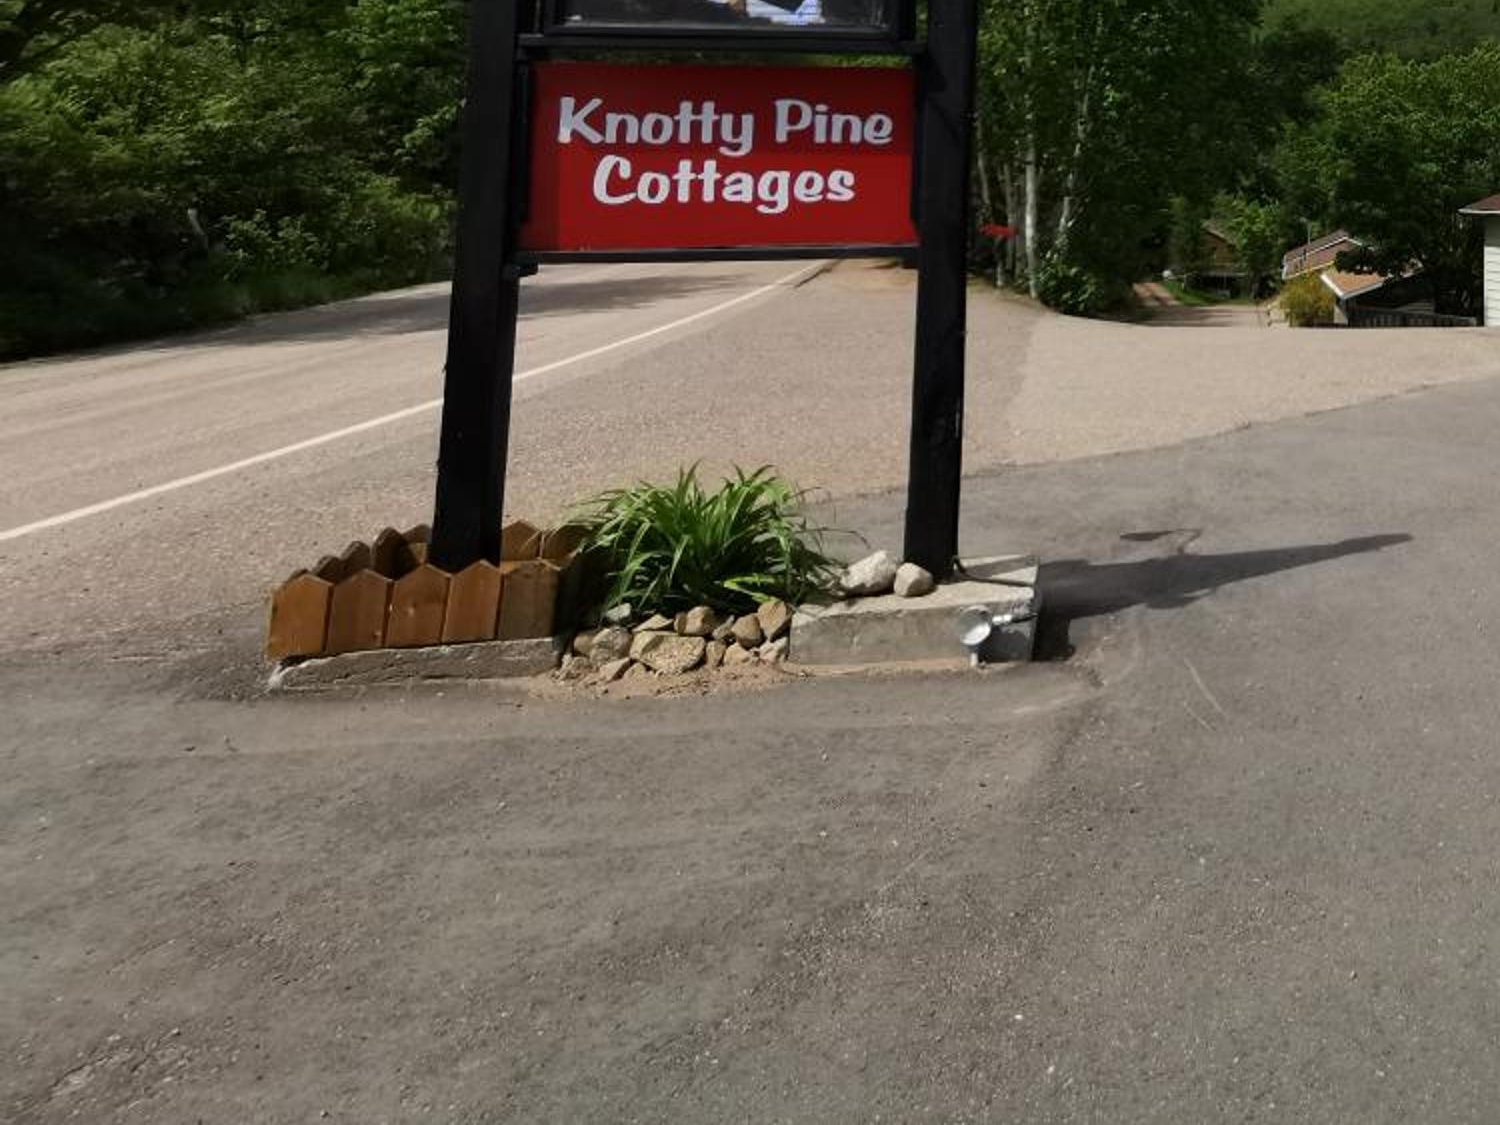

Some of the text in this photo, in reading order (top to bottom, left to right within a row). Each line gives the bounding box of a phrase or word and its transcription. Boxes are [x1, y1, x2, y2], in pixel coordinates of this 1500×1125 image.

[557, 97, 893, 156] Knotty Pine
[593, 155, 856, 214] Cottages
